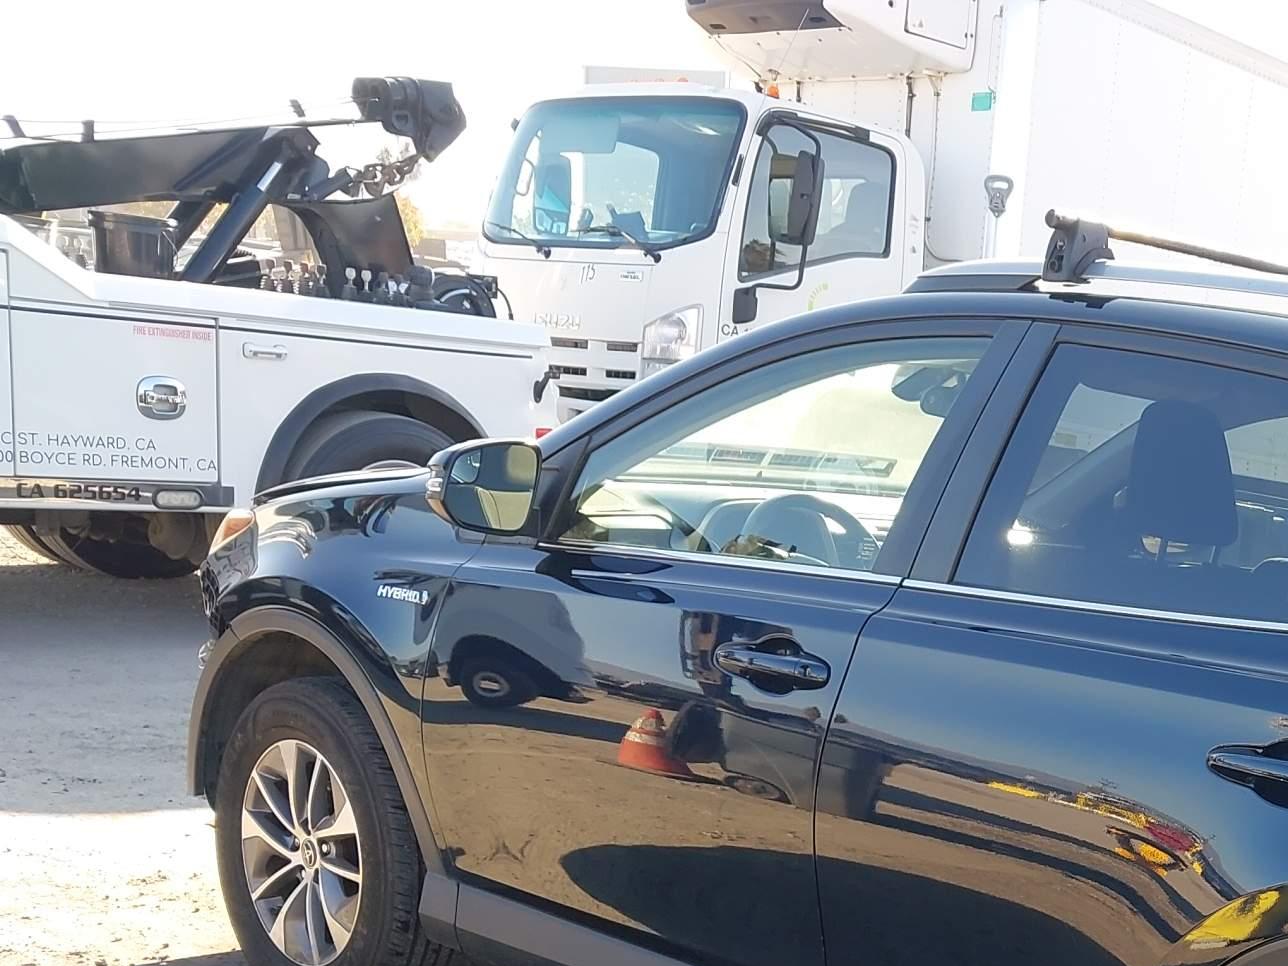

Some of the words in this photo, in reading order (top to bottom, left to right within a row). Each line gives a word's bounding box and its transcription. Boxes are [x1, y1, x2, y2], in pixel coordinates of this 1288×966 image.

[133, 325, 146, 336] FIRE
[721, 323, 739, 336] CA
[17, 432, 42, 446] ST.
[135, 437, 156, 451] CA
[20, 450, 77, 466] BOYCE
[83, 453, 106, 467] RD.
[110, 454, 192, 472] FREMONT,
[196, 458, 217, 472] CA
[16, 482, 45, 499] CA
[53, 483, 142, 501] 625654
[377, 584, 420, 604] HYBRID
